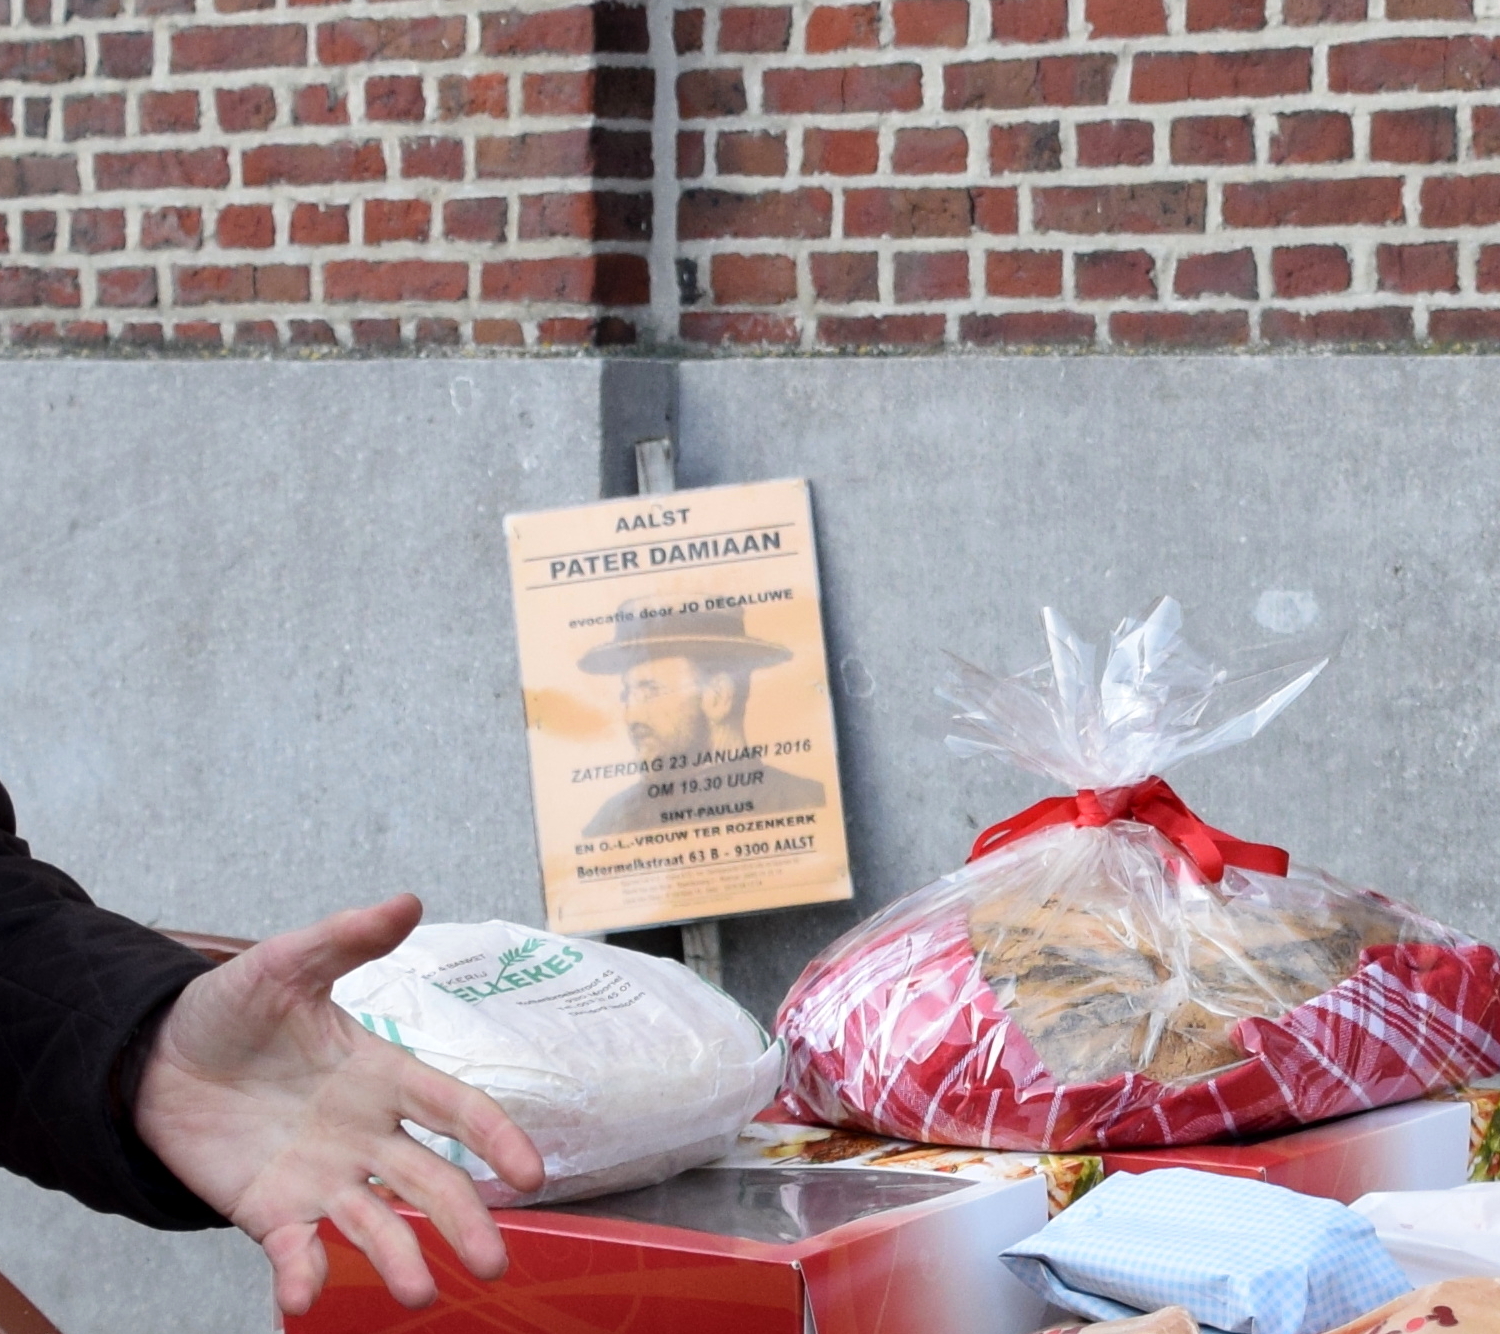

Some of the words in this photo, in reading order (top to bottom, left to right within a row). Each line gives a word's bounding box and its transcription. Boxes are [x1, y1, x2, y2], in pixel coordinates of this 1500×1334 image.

[616, 508, 688, 530] AALST
[551, 551, 637, 577] PATER
[650, 533, 779, 564] DAMIAAN
[567, 608, 635, 630] evocatie
[637, 603, 674, 621] door
[677, 600, 701, 615] JO
[703, 587, 795, 611] DECALUWE
[569, 756, 665, 784] ZATERDAG
[667, 753, 689, 770] 23
[690, 742, 770, 767] JANUARI
[772, 737, 813, 757] 2016
[645, 781, 678, 800] OM
[680, 775, 724, 795] 19.30
[725, 770, 765, 790] UUR
[658, 799, 756, 824] SINT-PAULUS
[573, 841, 595, 855] EN
[692, 825, 721, 840] TER
[724, 812, 817, 836] ROZENKERK
[687, 848, 707, 864] 63
[709, 847, 721, 861] B
[733, 840, 770, 858] 9300
[772, 833, 816, 853] AALST
[432, 944, 584, 1005] ELLEKES
